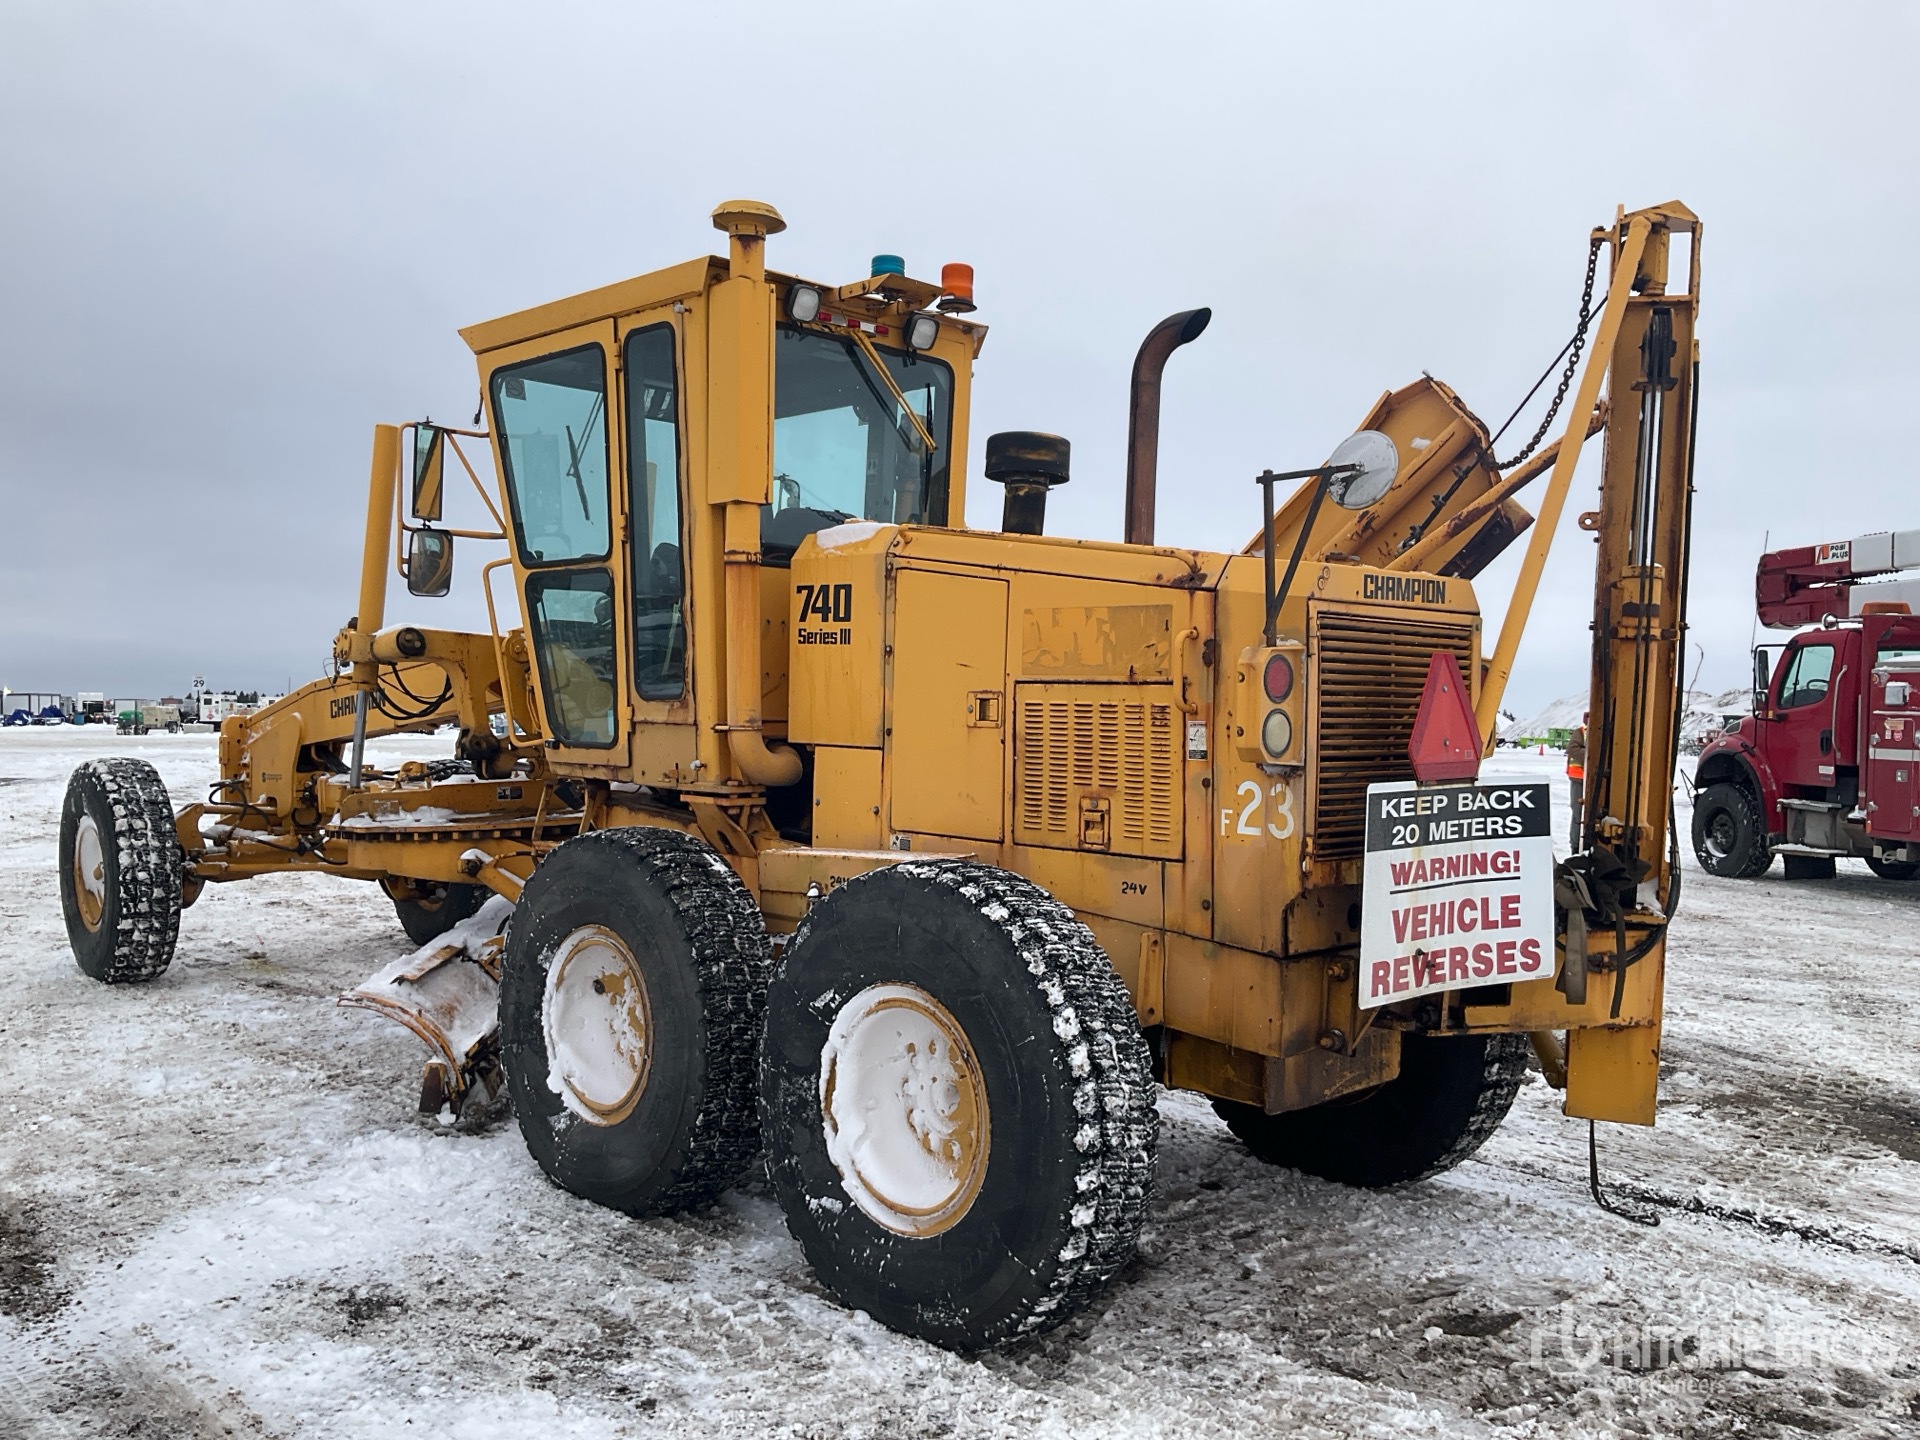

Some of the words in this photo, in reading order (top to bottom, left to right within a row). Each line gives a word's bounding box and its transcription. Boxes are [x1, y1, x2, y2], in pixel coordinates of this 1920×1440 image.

[1831, 551, 1849, 559] PLUS
[796, 584, 852, 622] 740
[1363, 574, 1446, 604] CHAMPION
[797, 628, 838, 645] Series
[839, 628, 851, 645] III
[193, 679, 205, 688] 29
[1220, 808, 1233, 836] F
[1236, 780, 1295, 840] 23
[1381, 795, 1449, 818] KEEP
[1457, 789, 1535, 812] BACK
[1391, 824, 1420, 846] 20
[1429, 815, 1523, 842] METERS
[1390, 850, 1521, 886] WARNING!
[1121, 881, 1147, 895] 24V
[1391, 894, 1522, 944] VEHICLE
[1371, 938, 1541, 998] REVERSES
